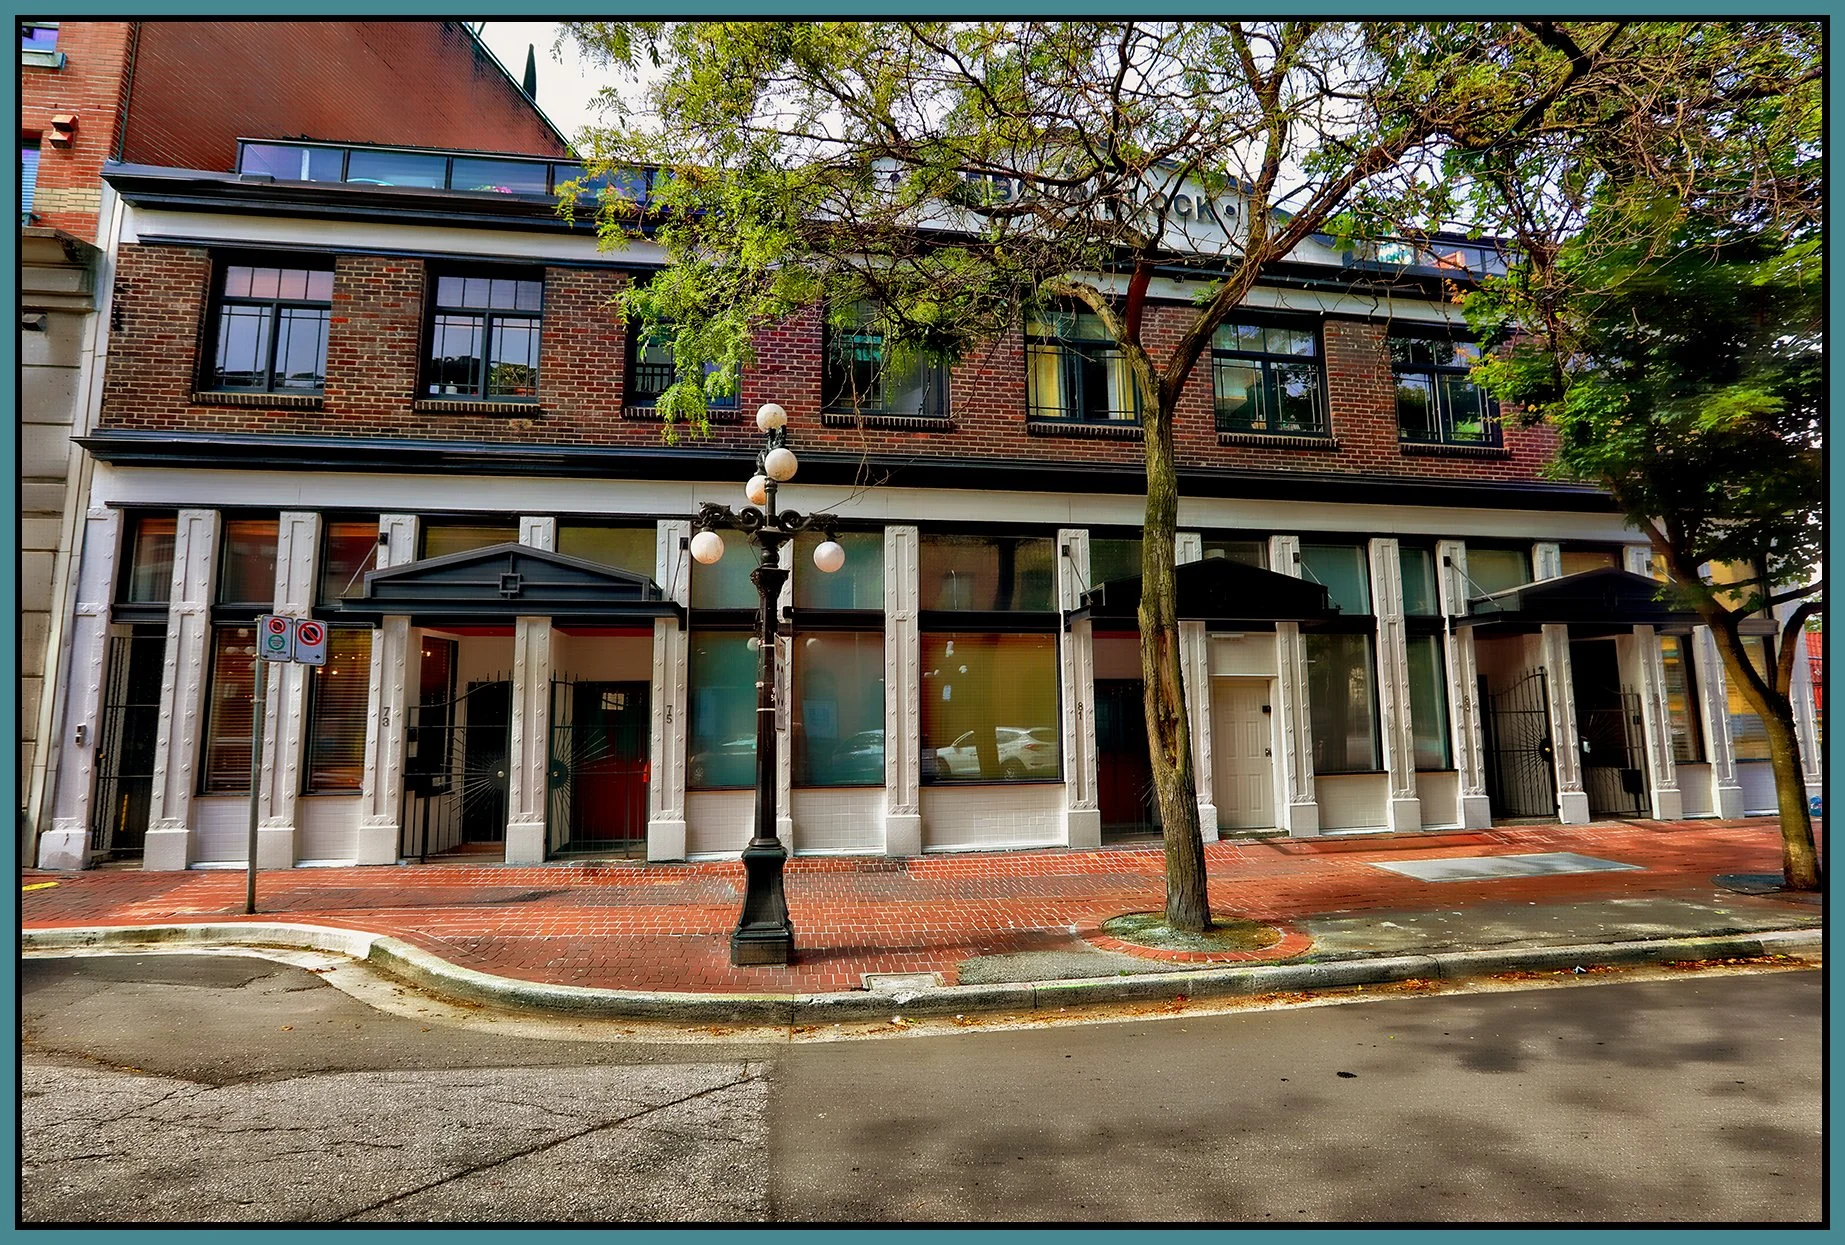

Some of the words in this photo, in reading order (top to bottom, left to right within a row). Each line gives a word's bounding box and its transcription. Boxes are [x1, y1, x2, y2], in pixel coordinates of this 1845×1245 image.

[382, 706, 391, 728] 73
[666, 704, 673, 724] 75
[1077, 701, 1084, 720] 81
